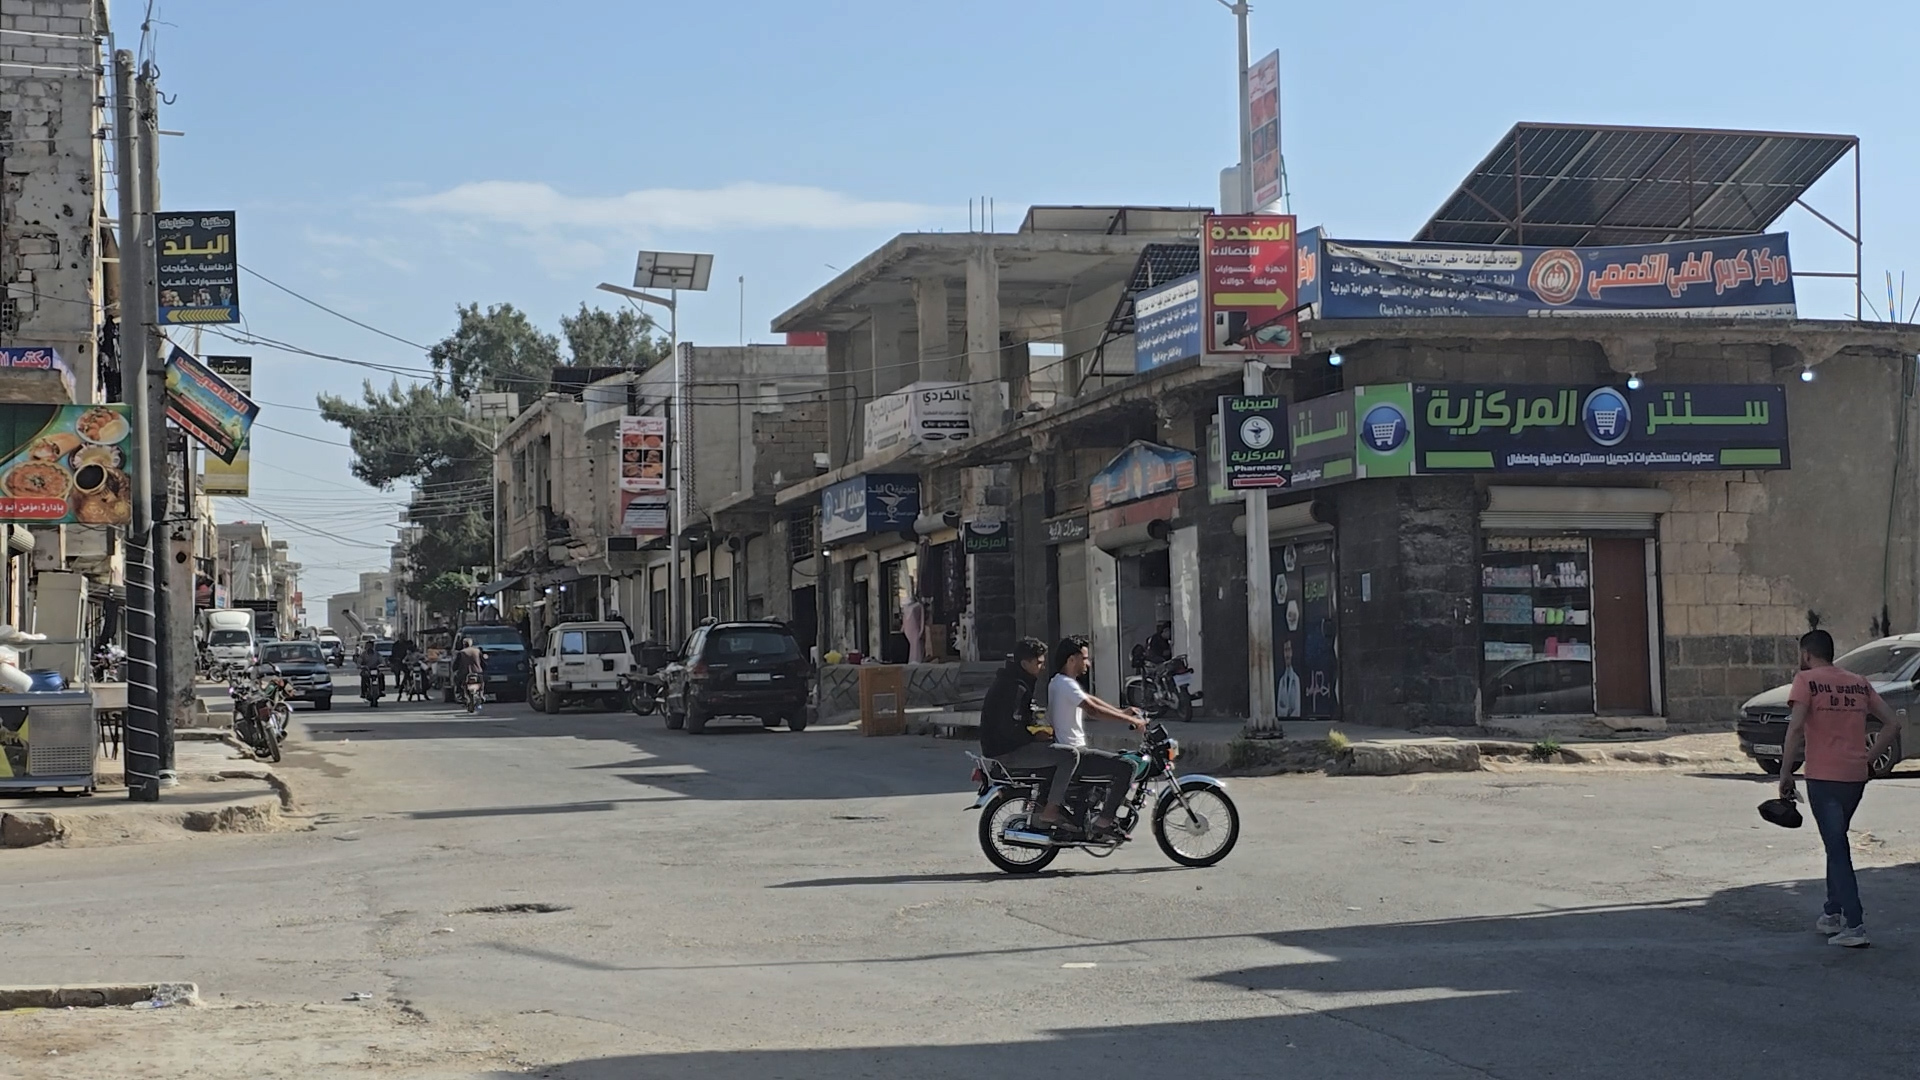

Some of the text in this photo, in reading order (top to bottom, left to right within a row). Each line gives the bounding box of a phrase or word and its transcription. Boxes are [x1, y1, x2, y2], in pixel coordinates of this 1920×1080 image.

[200, 216, 231, 230] مكتبة
[1211, 221, 1290, 240] المتحدة
[163, 234, 229, 260] البلد
[198, 263, 233, 273] قرطاسية
[1667, 250, 1713, 298] الطبي
[1713, 249, 1752, 296] كريم
[1751, 248, 1788, 286] مركز
[1587, 253, 1669, 300] التخصصي
[12, 350, 51, 369] مكتب
[922, 389, 960, 405] الكردي
[1231, 398, 1279, 412] الصيدلية
[1426, 389, 1769, 435] سنتر المركزية
[1231, 449, 1285, 463] المركزية
[1540, 453, 1562, 465] طبية
[1563, 452, 1606, 466] مستلزمات
[1606, 452, 1634, 466] تجميل
[1634, 452, 1681, 465] مستحضرات
[1681, 452, 1715, 465] عطورات
[1234, 464, 1283, 472] Pharmacy
[967, 537, 1007, 550] المركزية
[1809, 681, 1832, 697] You
[1830, 695, 1856, 707] to be
